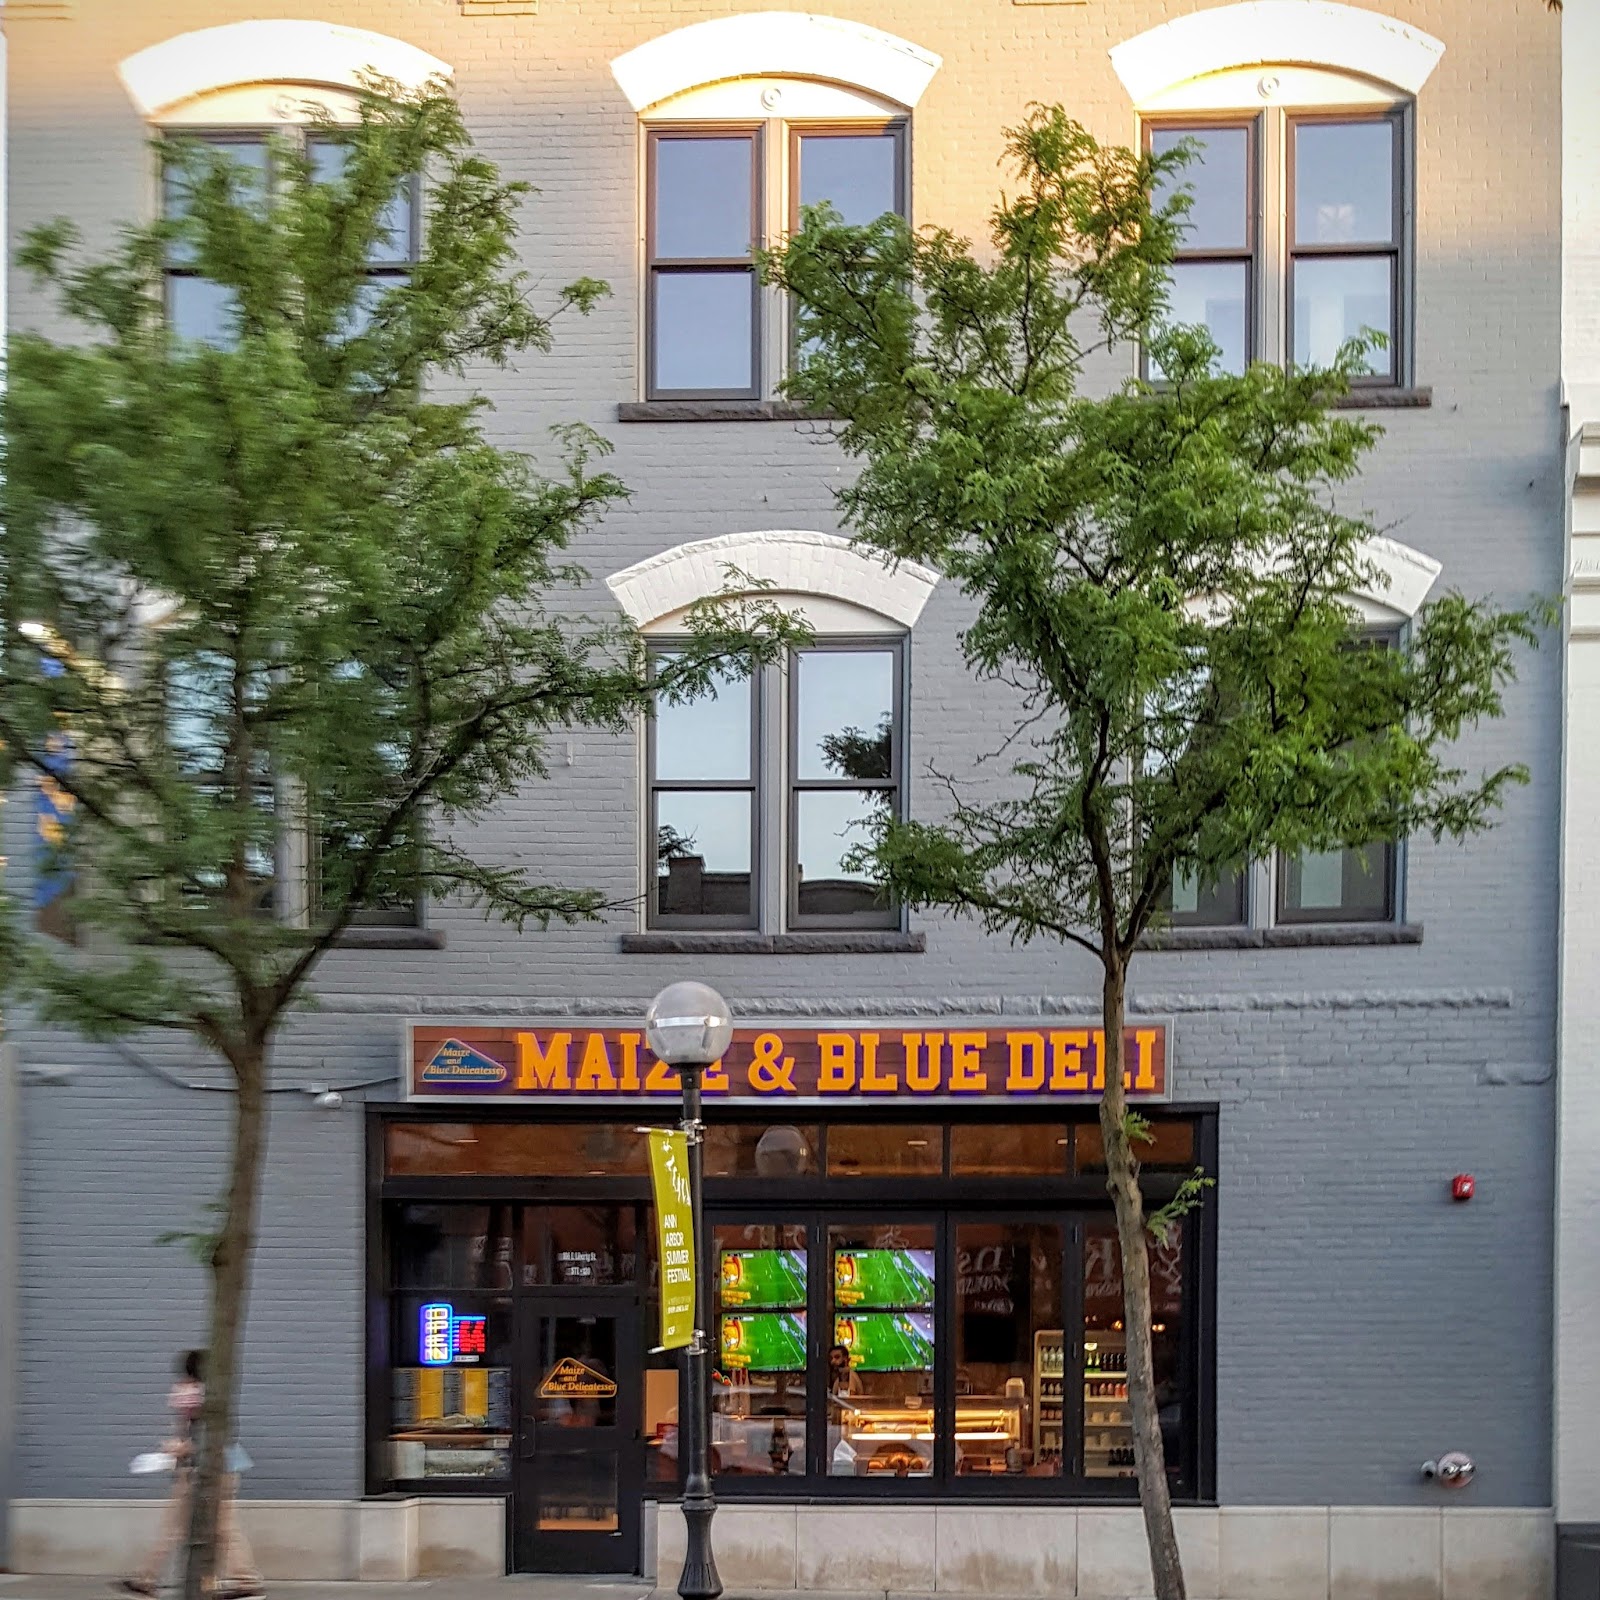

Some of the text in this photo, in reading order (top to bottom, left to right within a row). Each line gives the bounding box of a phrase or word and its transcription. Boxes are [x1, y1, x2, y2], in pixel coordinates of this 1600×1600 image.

[443, 1047, 471, 1058] Maize
[446, 1056, 463, 1065] and
[748, 1032, 798, 1092] &
[816, 1032, 988, 1092] BLUE
[429, 1065, 450, 1075] Blue
[664, 1213, 678, 1229] ANN
[665, 1231, 685, 1248] ARBOR
[665, 1249, 690, 1266] SUMMER
[667, 1266, 692, 1284] FESTIVAL
[424, 1307, 449, 1362] OPEN
[560, 1365, 586, 1376] Maize
[563, 1374, 578, 1382] and
[548, 1381, 567, 1391] Blue
